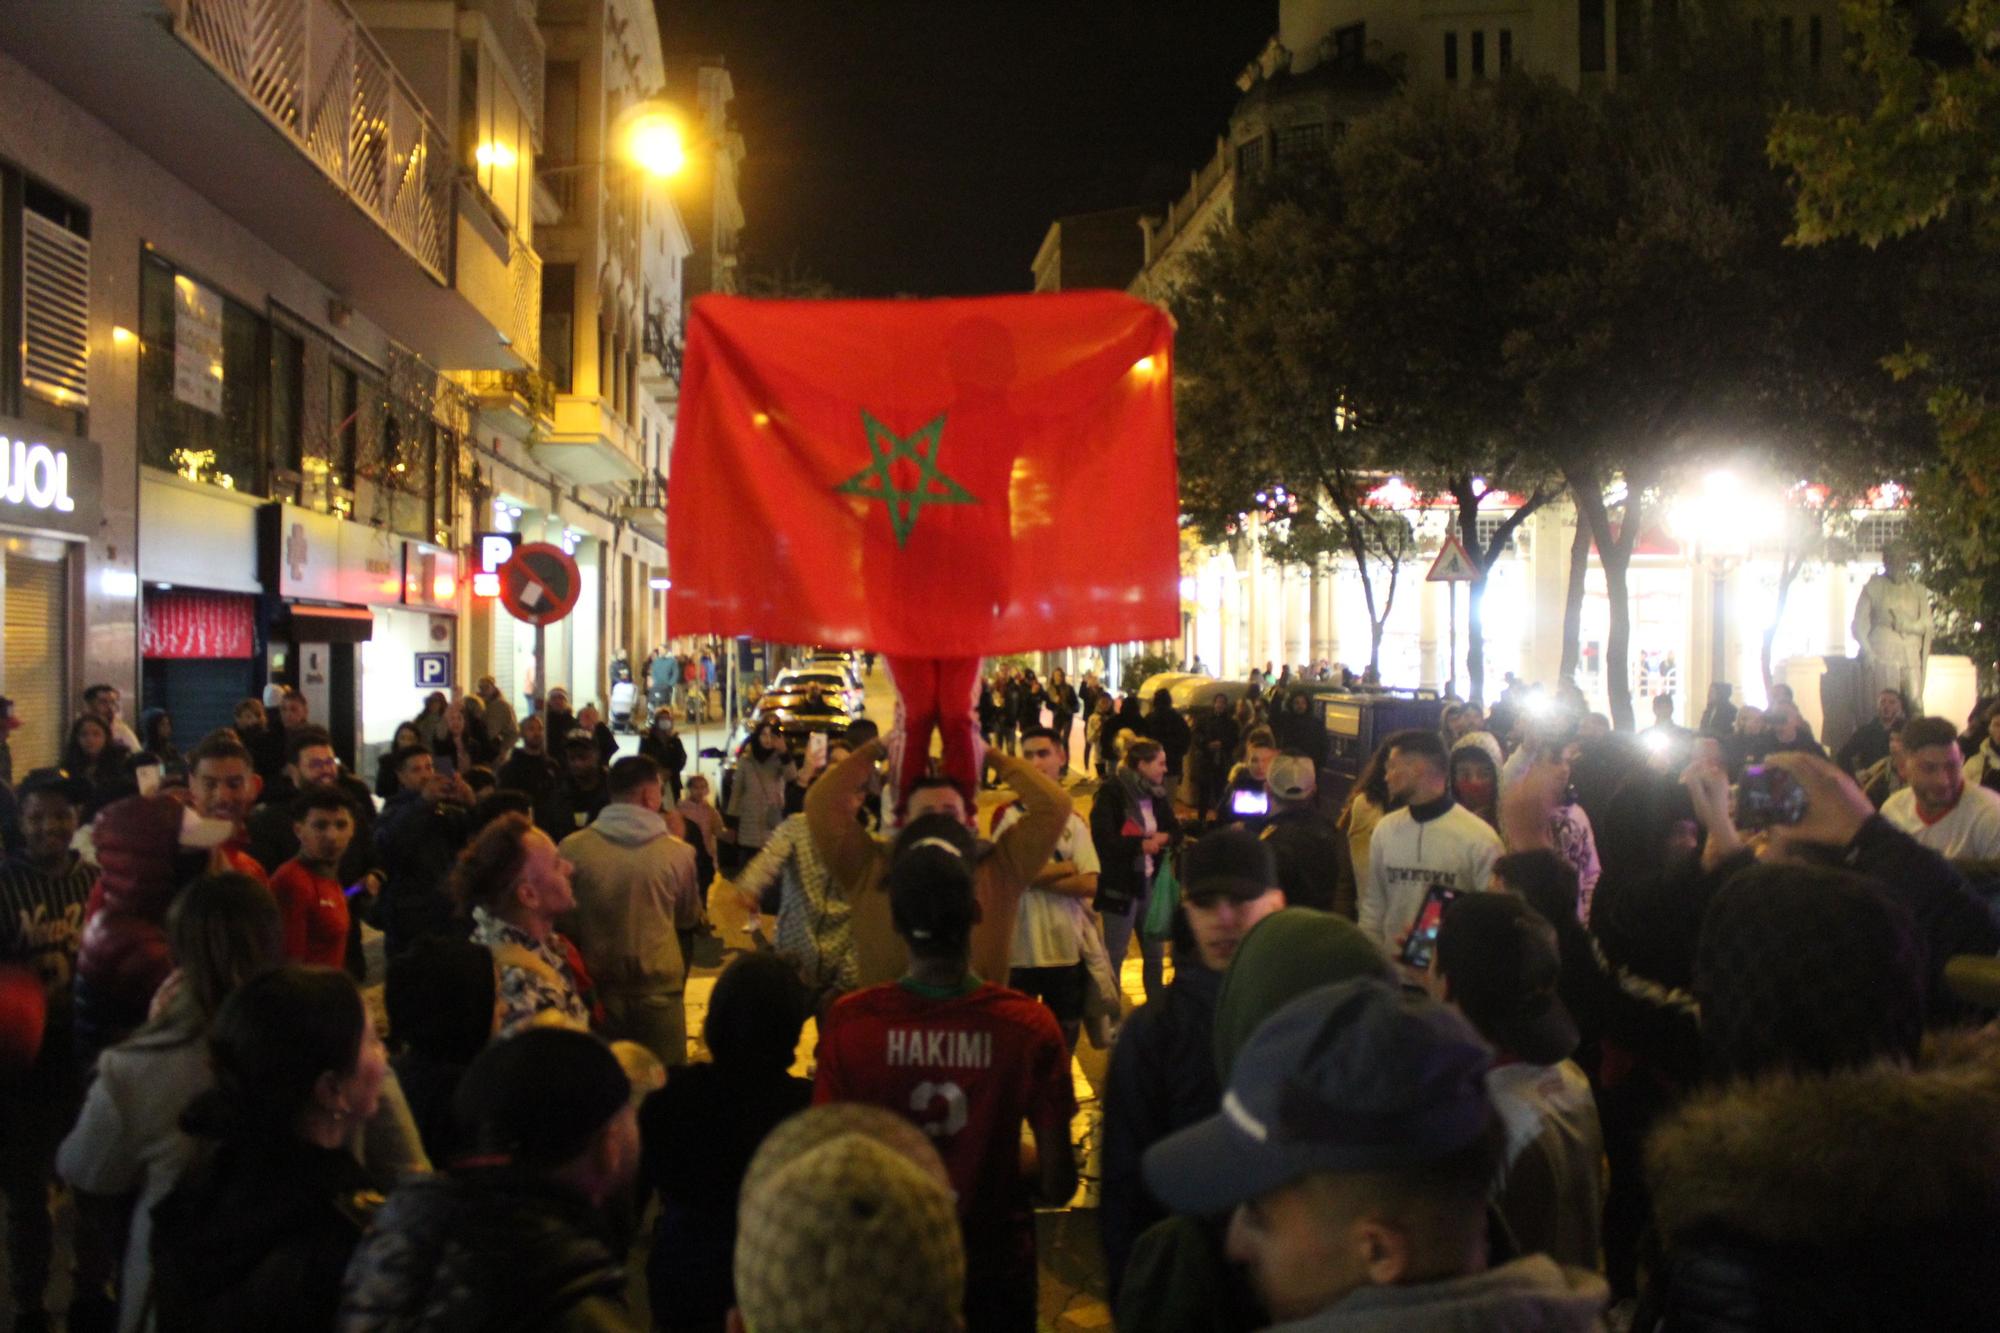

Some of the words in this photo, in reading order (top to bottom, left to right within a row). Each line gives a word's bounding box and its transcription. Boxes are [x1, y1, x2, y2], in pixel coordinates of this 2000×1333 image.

[482, 536, 513, 573] P
[423, 659, 442, 682] P
[887, 1029, 992, 1068] HAKIMI
